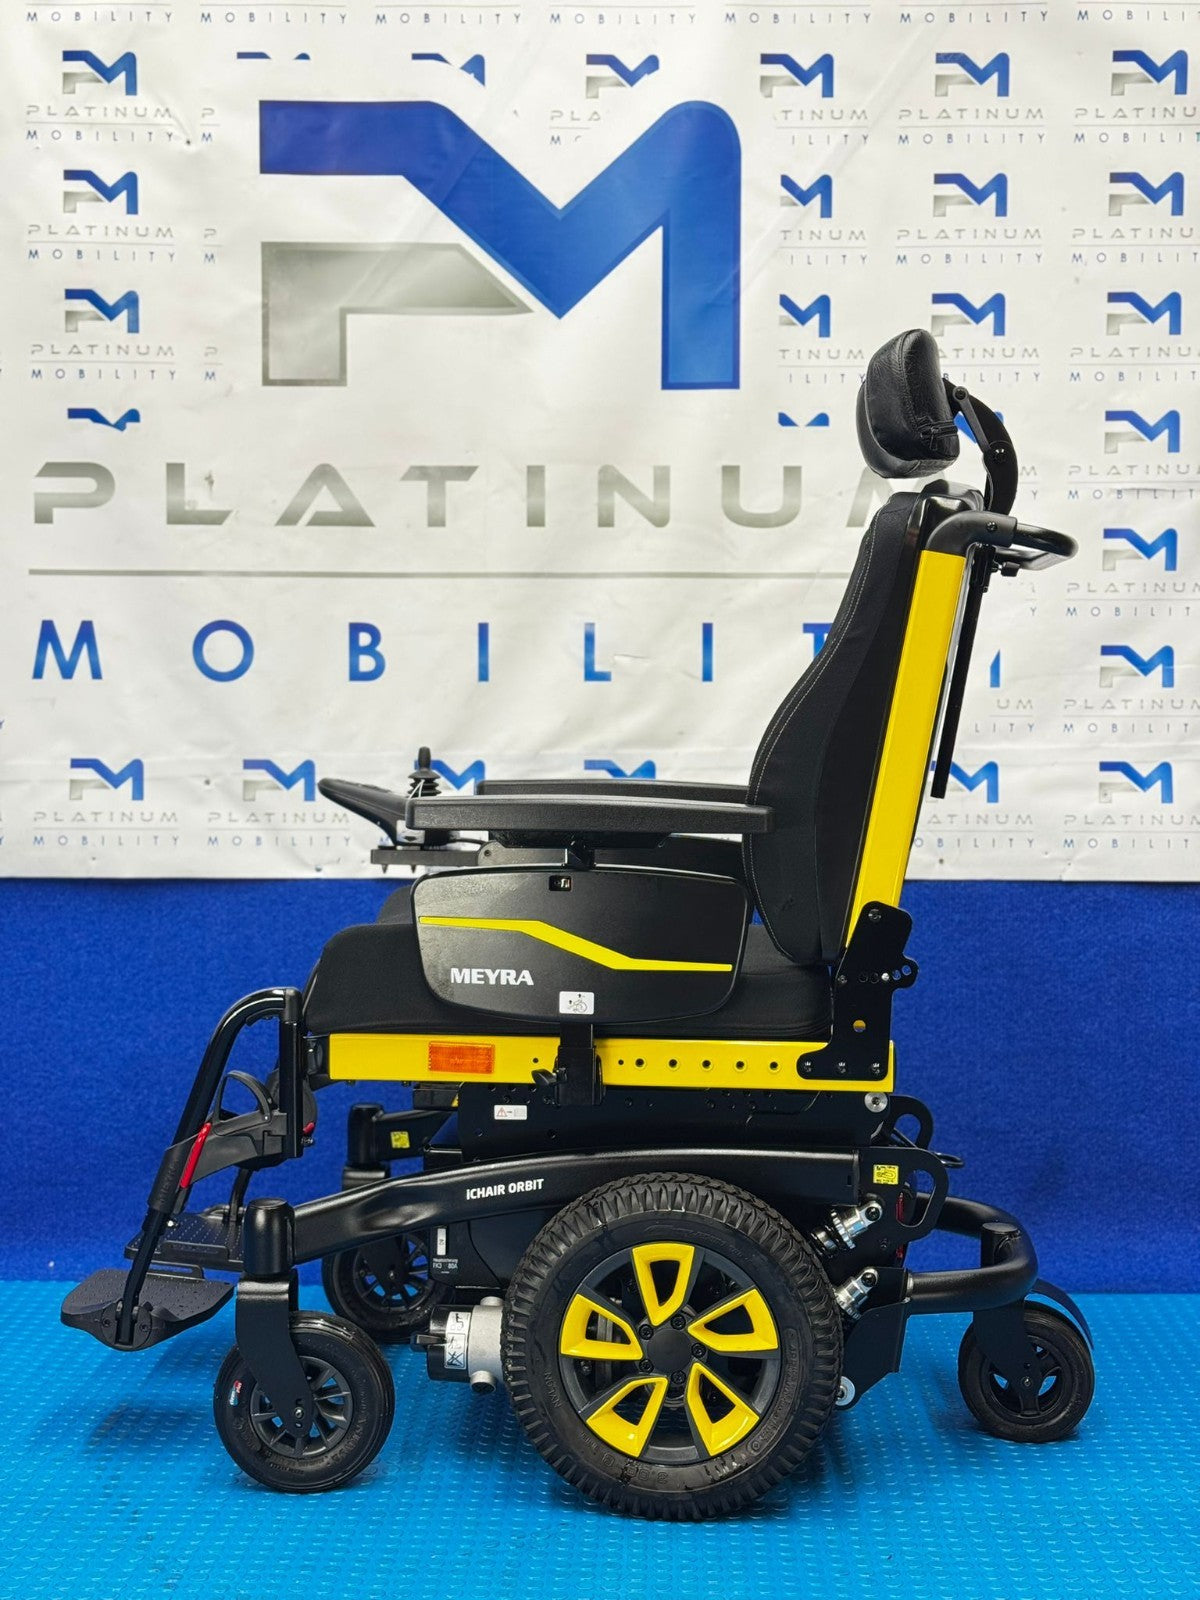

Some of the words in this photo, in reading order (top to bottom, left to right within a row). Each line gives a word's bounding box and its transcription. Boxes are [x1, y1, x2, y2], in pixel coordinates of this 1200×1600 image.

[26, 11, 172, 22] MOBILITY
[200, 12, 346, 24] MOBILITY
[375, 13, 520, 25] MOBILITY
[550, 13, 695, 24] MOBILITY
[725, 11, 871, 24] MOBILITY
[900, 9, 1048, 23] MOBILITY
[26, 105, 172, 118] PLATINUM
[774, 109, 868, 120] TINUM
[899, 108, 1043, 119] PLATINUM
[26, 129, 173, 142] MOBILITY
[898, 132, 1044, 144] MOBILITY
[28, 224, 173, 238] PLATINUM
[897, 229, 1041, 240] PLATINUM
[28, 248, 175, 261] MOBILITY
[896, 253, 1042, 265] MOBILITY
[31, 344, 174, 356] PLATINUM
[1071, 346, 1200, 358] PLATINU
[31, 368, 176, 380] MOBILITY
[1069, 464, 1200, 475] PLATINU
[34, 812, 177, 822] PLATINUM
[209, 811, 351, 823] PLATINUM
[32, 835, 179, 846] MOBILITY
[208, 836, 350, 847] MOBILITY
[450, 967, 534, 986] MEYRA
[508, 1178, 544, 1193] ORBIT
